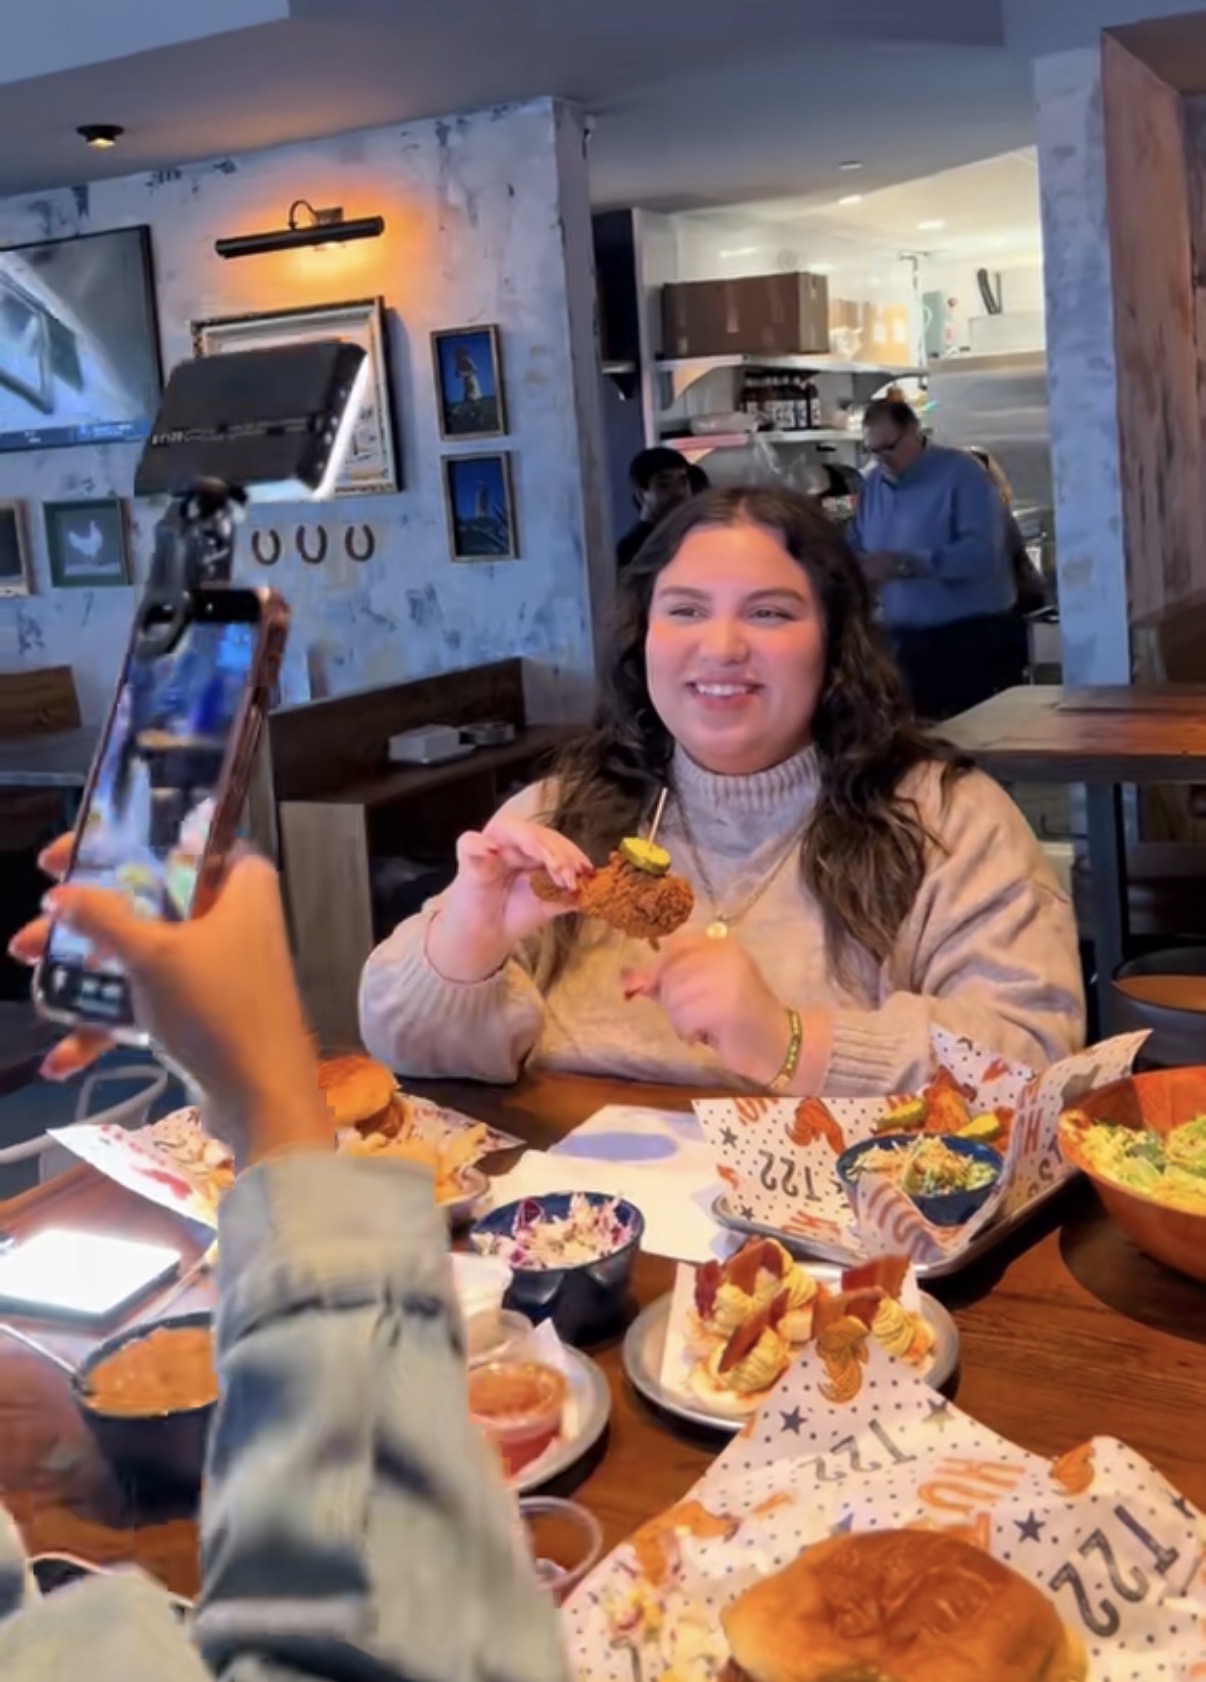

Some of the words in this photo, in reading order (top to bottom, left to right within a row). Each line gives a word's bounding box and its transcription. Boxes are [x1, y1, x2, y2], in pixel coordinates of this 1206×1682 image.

[758, 1149, 822, 1203] T22
[797, 1419, 917, 1483] T22
[1049, 1504, 1181, 1638] T22
